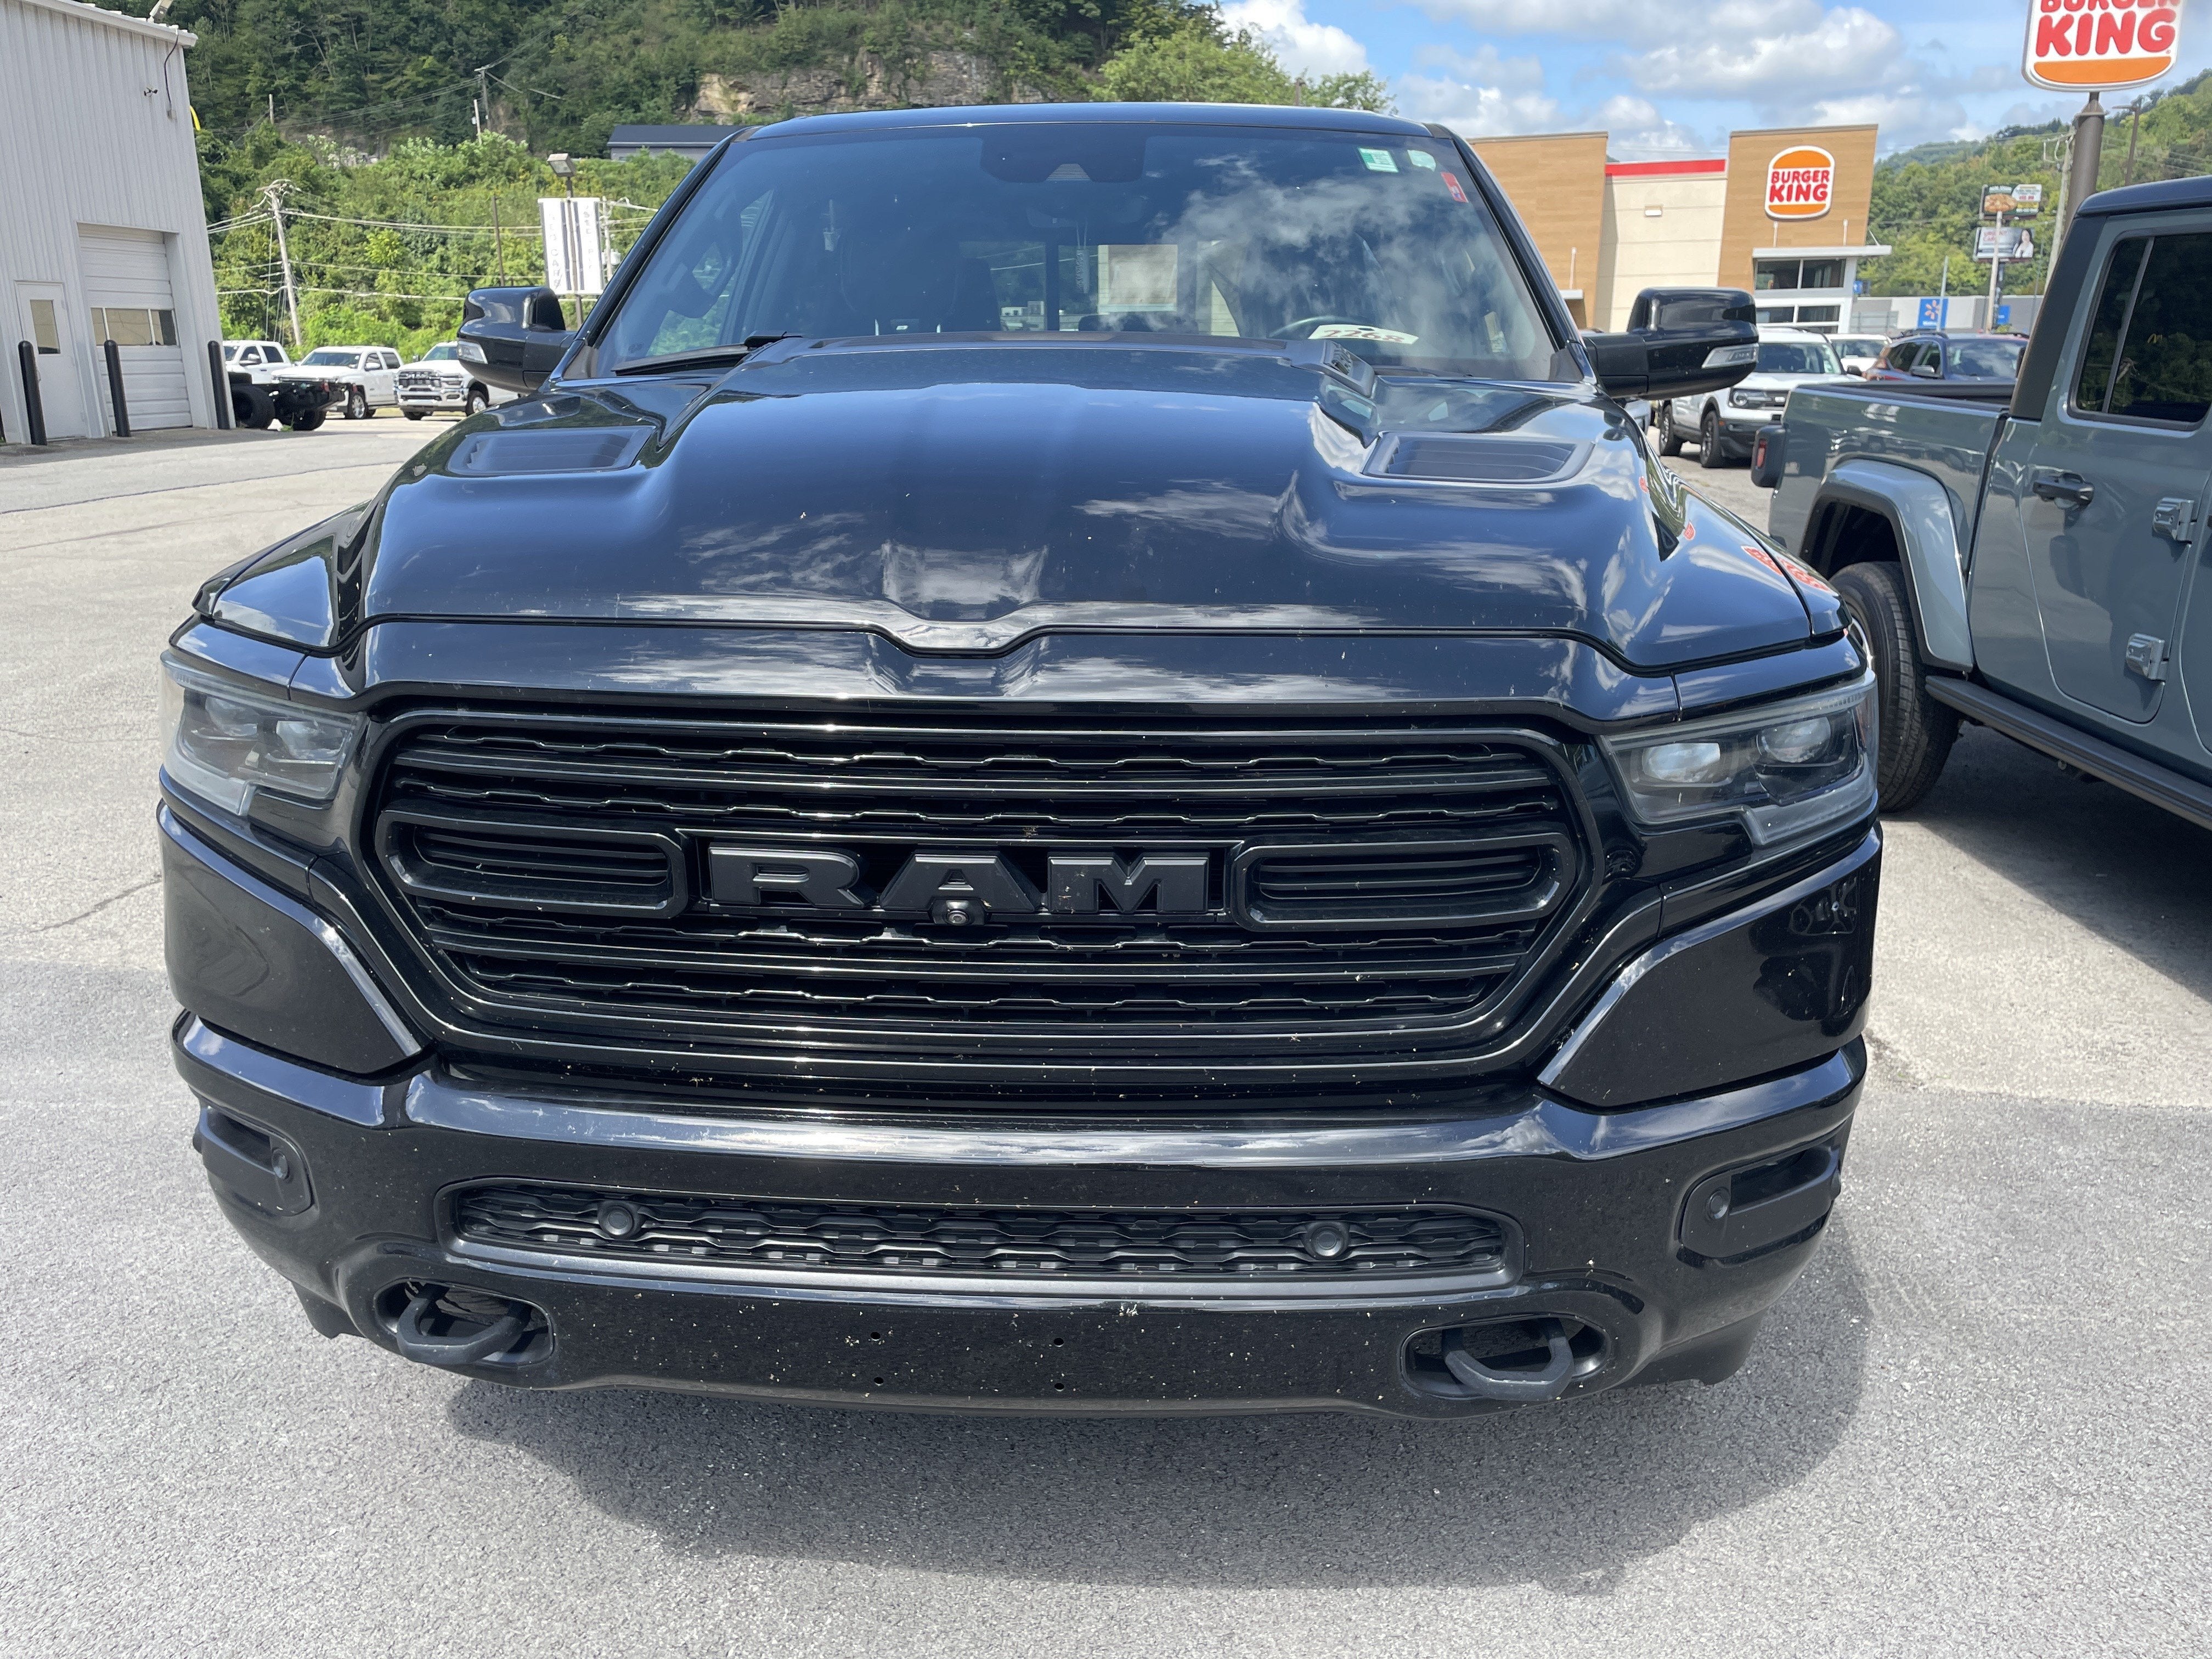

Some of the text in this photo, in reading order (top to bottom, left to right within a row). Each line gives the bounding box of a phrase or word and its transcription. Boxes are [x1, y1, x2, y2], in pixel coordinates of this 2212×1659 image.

[2035, 8, 2176, 57] KING
[1771, 170, 1830, 183] BURGER
[1769, 184, 1828, 202] KING
[1324, 330, 1404, 342] 2268
[708, 847, 1209, 913] RAM
